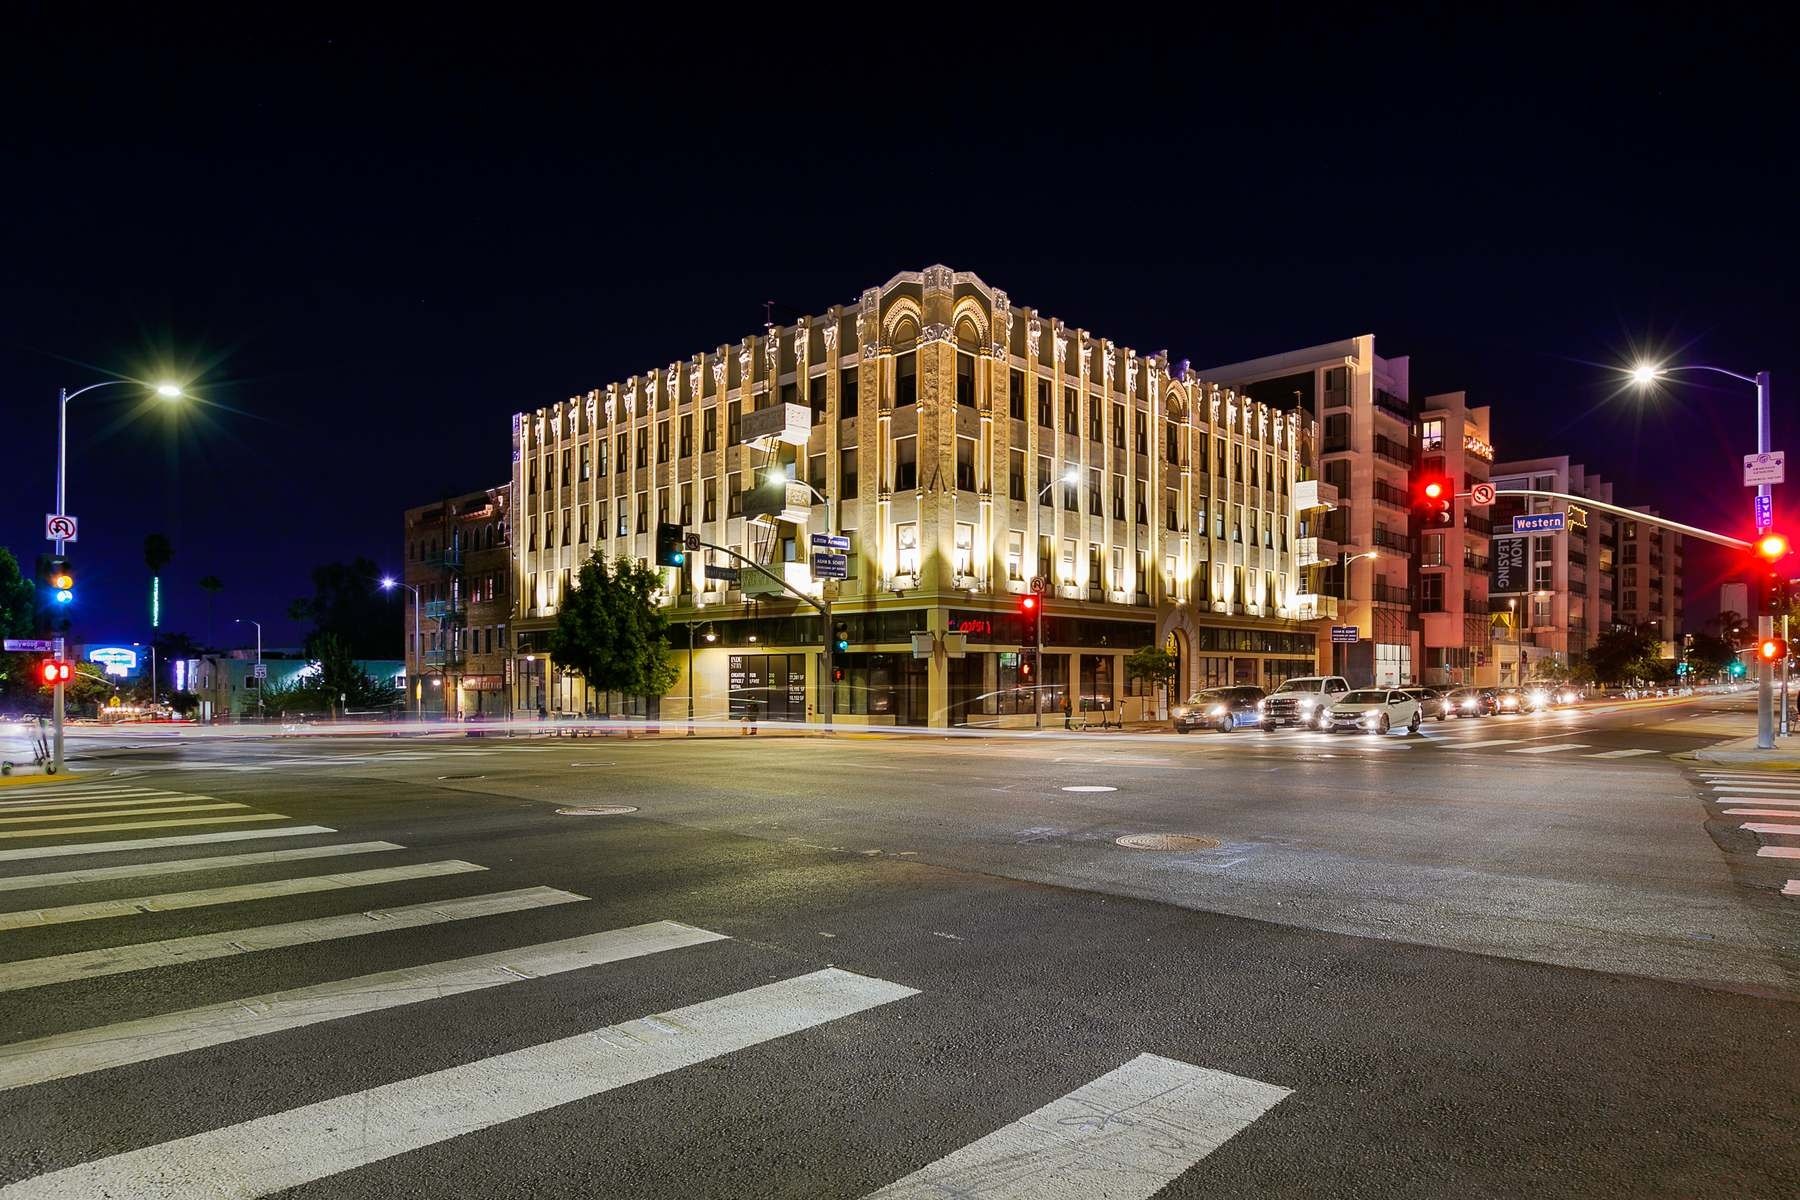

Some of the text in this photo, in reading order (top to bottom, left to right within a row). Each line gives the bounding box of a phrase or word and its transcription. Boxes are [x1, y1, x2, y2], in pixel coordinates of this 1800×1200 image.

[1517, 518, 1561, 529] Western
[1762, 497, 1770, 525] SYNC
[828, 539, 848, 547] Armenia
[1510, 538, 1523, 568] NOW
[1497, 539, 1510, 589] LEASING
